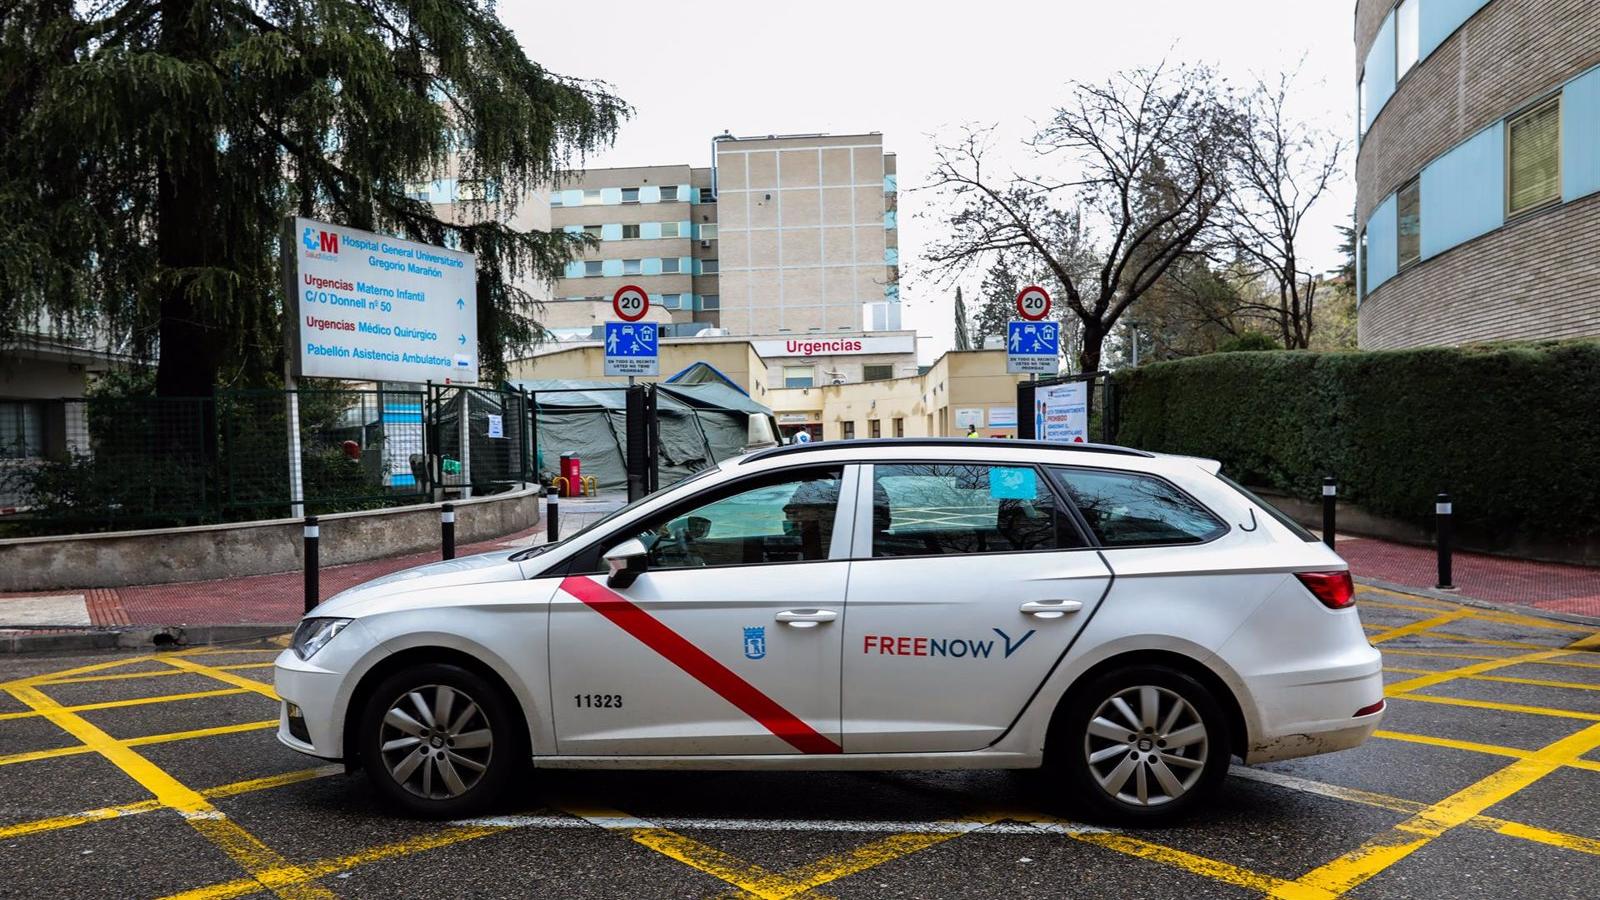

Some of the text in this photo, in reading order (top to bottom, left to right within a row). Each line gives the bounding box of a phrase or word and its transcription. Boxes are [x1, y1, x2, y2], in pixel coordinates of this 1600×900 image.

[320, 231, 339, 254] M
[342, 235, 464, 269] Hospital General Universitario
[368, 256, 442, 278] Gregorio Marañón
[304, 273, 425, 302] Urgencias Materno Infantil
[380, 302, 392, 312] 50
[621, 297, 641, 309] 20
[1024, 297, 1043, 309] 20
[306, 315, 437, 341] Urgencias Médico Quirúrgico
[307, 343, 350, 358] Pabellón
[352, 347, 399, 362] Asistencia
[401, 352, 451, 367] Ambulatoria
[786, 339, 862, 356] Urgencias
[574, 694, 623, 708] 11323
